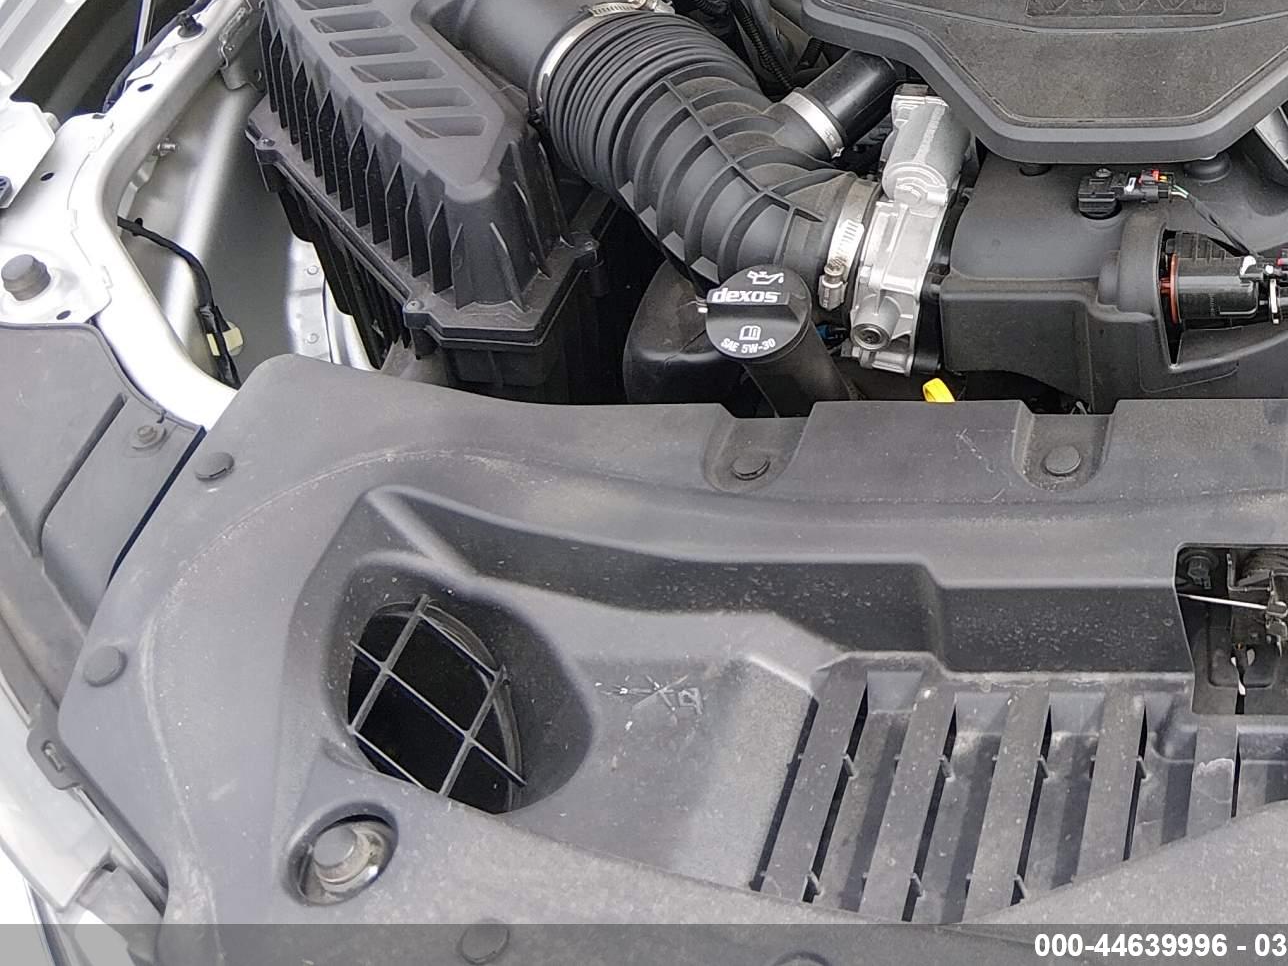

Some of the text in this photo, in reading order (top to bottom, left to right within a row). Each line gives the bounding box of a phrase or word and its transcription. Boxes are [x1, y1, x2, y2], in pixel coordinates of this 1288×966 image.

[712, 287, 781, 303] dexos
[720, 337, 776, 354] SAE 5W-30
